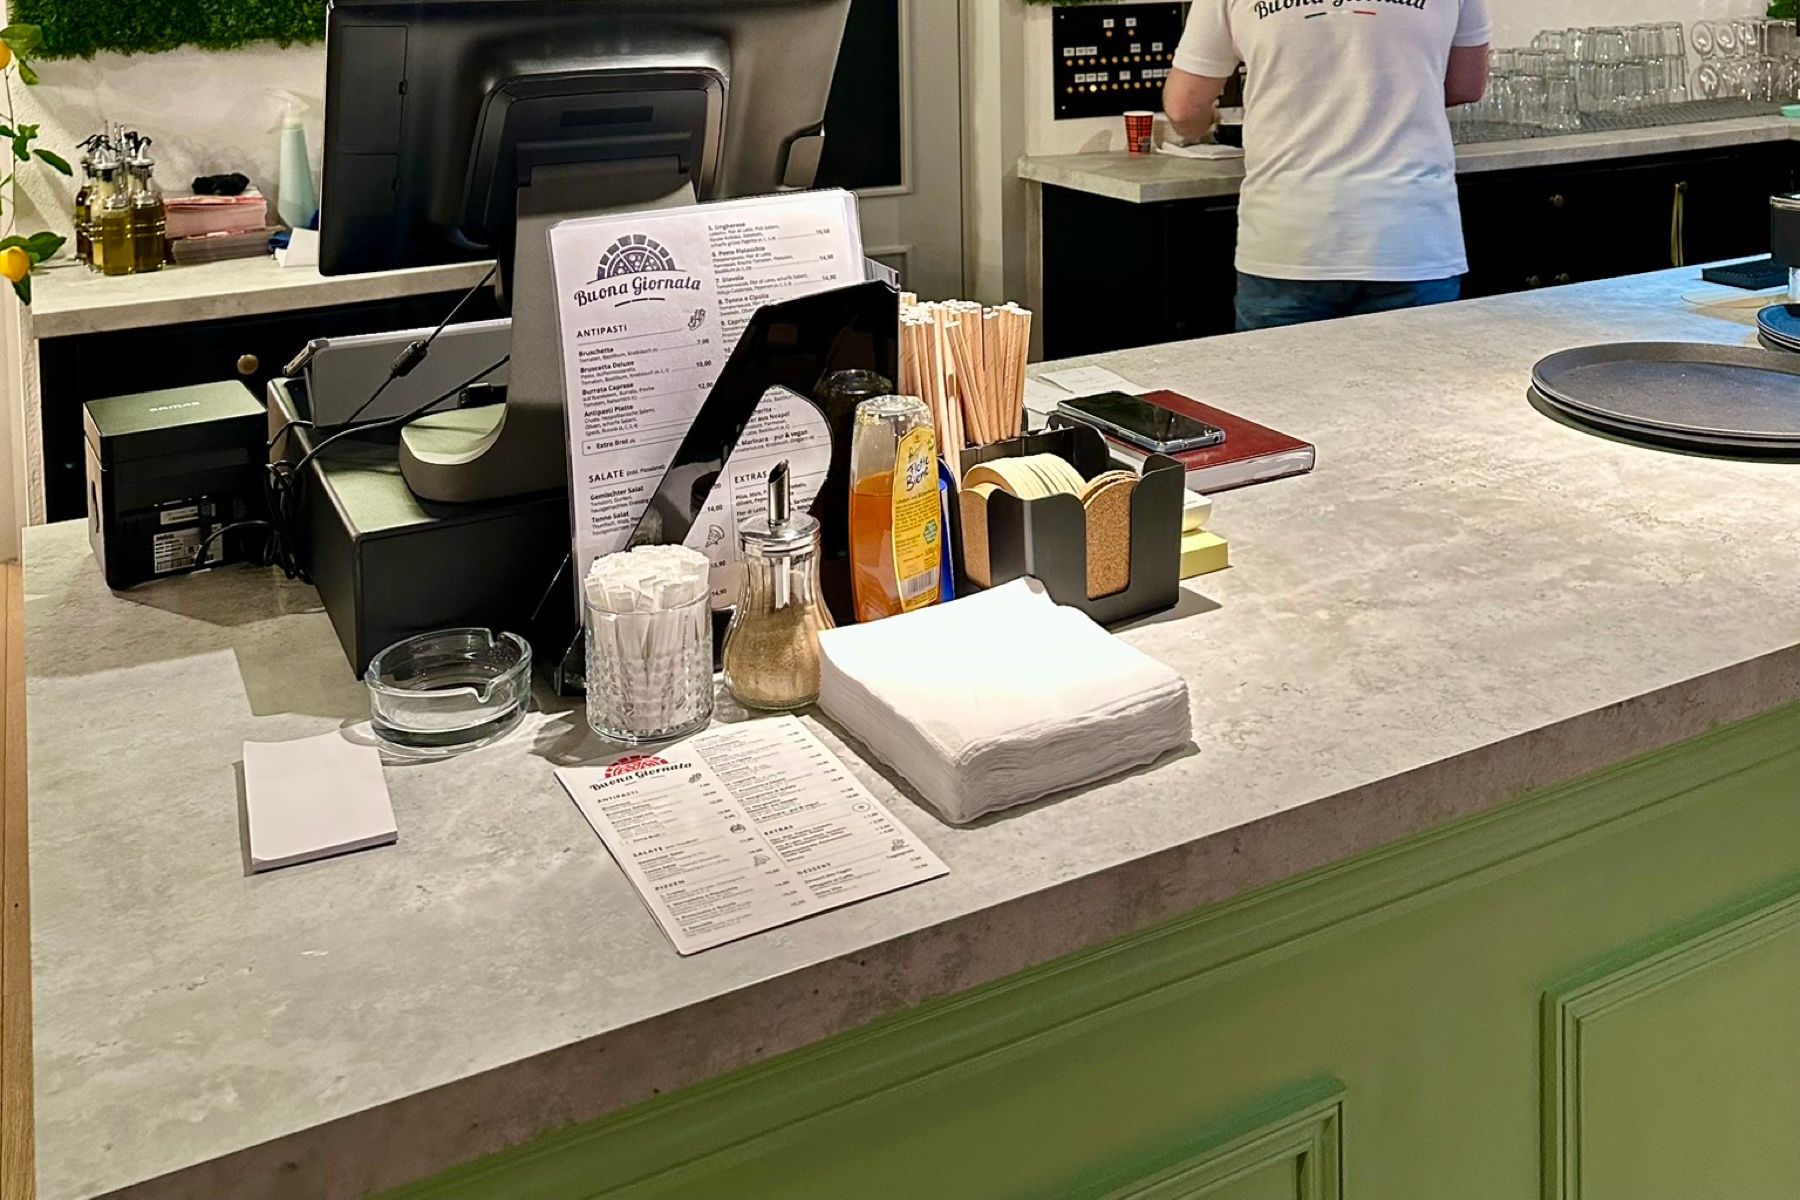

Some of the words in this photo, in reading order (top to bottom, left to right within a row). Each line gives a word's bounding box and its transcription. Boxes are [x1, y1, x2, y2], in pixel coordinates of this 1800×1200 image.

[573, 282, 628, 307] Buona
[632, 276, 701, 295] Giornata
[576, 324, 628, 338] ANTIPASTI
[579, 347, 614, 357] Bruschetta
[612, 361, 635, 369] Deluxe
[582, 387, 607, 395] Burrata
[608, 382, 634, 391] Caprese
[584, 408, 613, 417] Antipasti
[596, 441, 613, 449] Extra
[614, 438, 629, 446] Brot
[741, 437, 769, 445] Marinara
[588, 470, 624, 483] SALATE
[734, 471, 767, 484] EXTRAS
[590, 490, 627, 501] Gemischter
[628, 485, 644, 493] Salat
[592, 514, 612, 524] Tonno
[613, 510, 629, 519] Salat
[589, 775, 633, 791] Buona
[634, 762, 692, 779] Giornata
